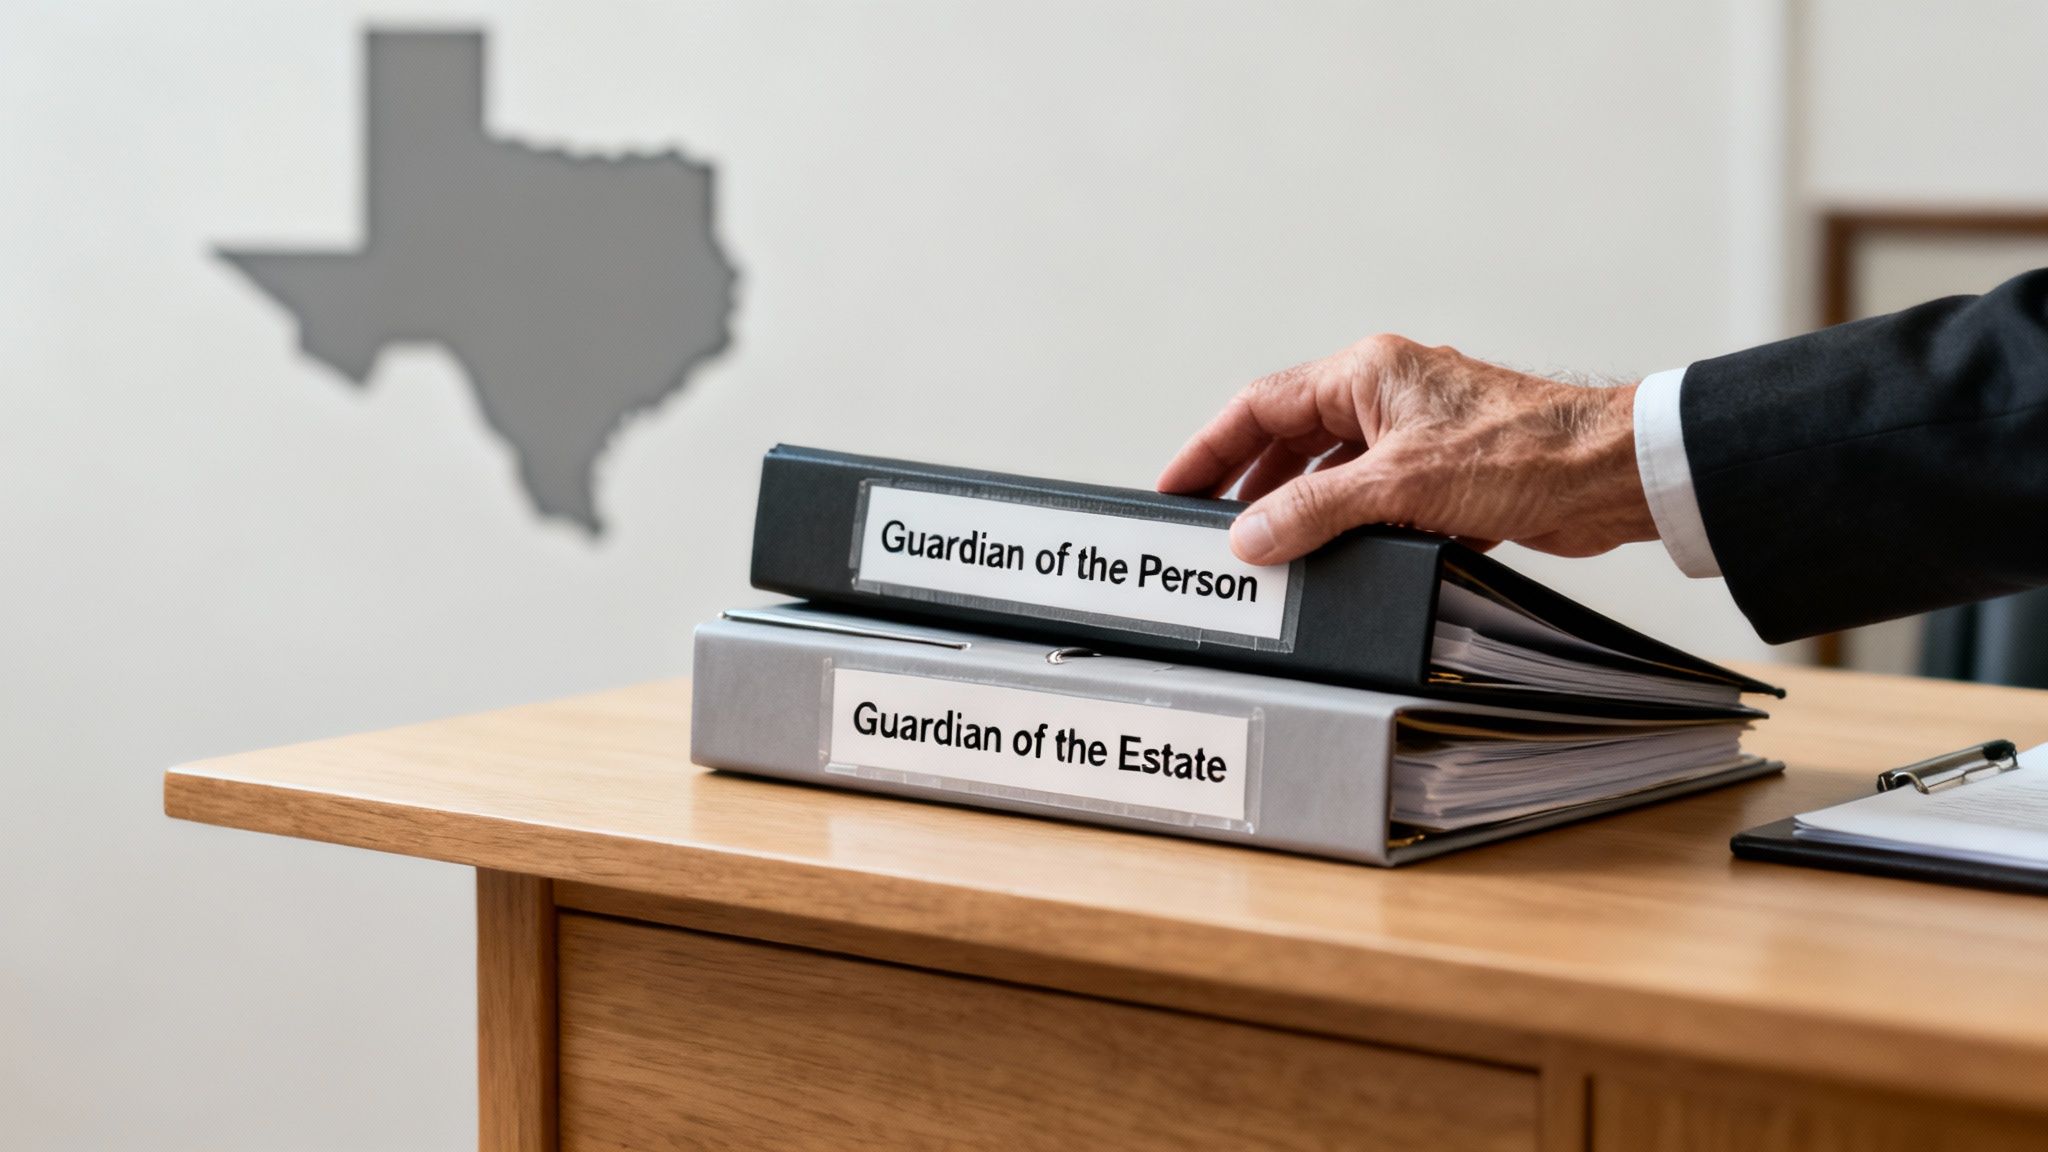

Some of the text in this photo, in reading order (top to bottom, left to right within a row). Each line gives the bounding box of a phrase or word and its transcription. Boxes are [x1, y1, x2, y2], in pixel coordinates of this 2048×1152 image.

[882, 520, 1258, 602] Guardian of the Person
[854, 702, 1226, 782] Guardian of the Estate
